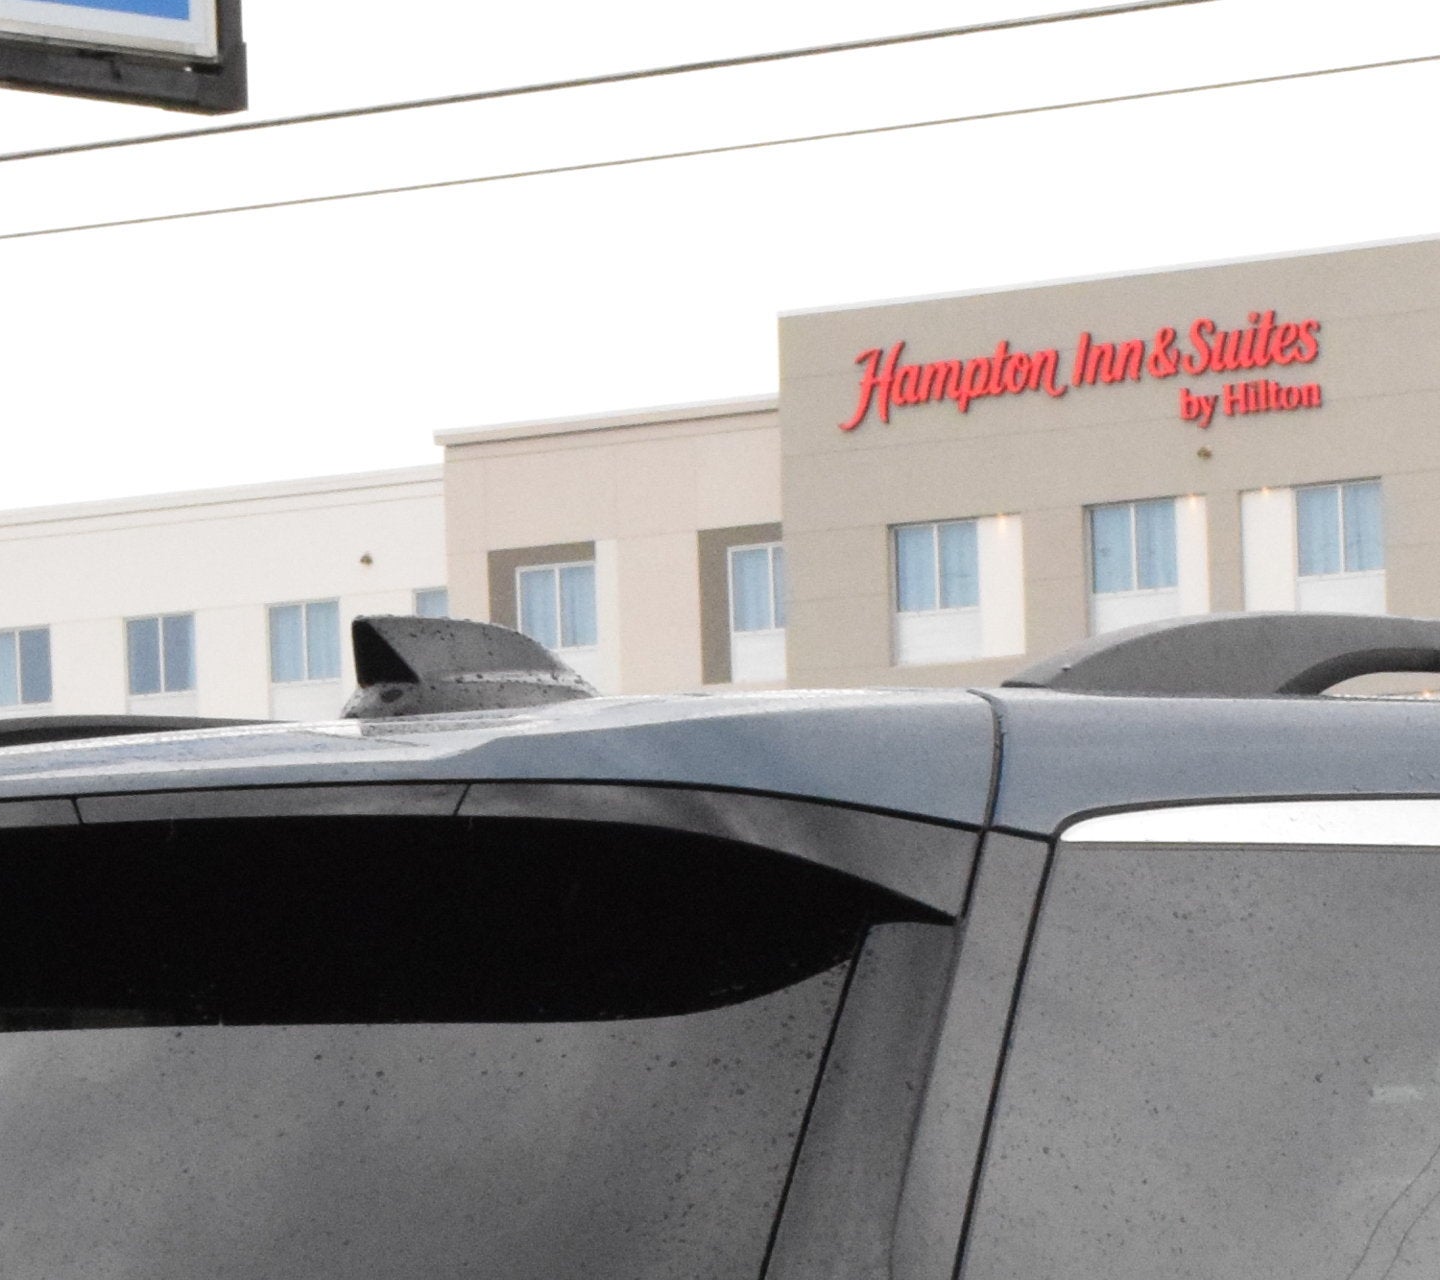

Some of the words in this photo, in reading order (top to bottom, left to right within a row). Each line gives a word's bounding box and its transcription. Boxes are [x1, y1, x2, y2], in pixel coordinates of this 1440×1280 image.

[838, 340, 1066, 431] Hampton
[1072, 331, 1144, 388] Inn
[1147, 326, 1181, 377] &
[1182, 309, 1321, 375] Suites
[1178, 387, 1218, 428] by
[1222, 379, 1323, 416] Hilton
